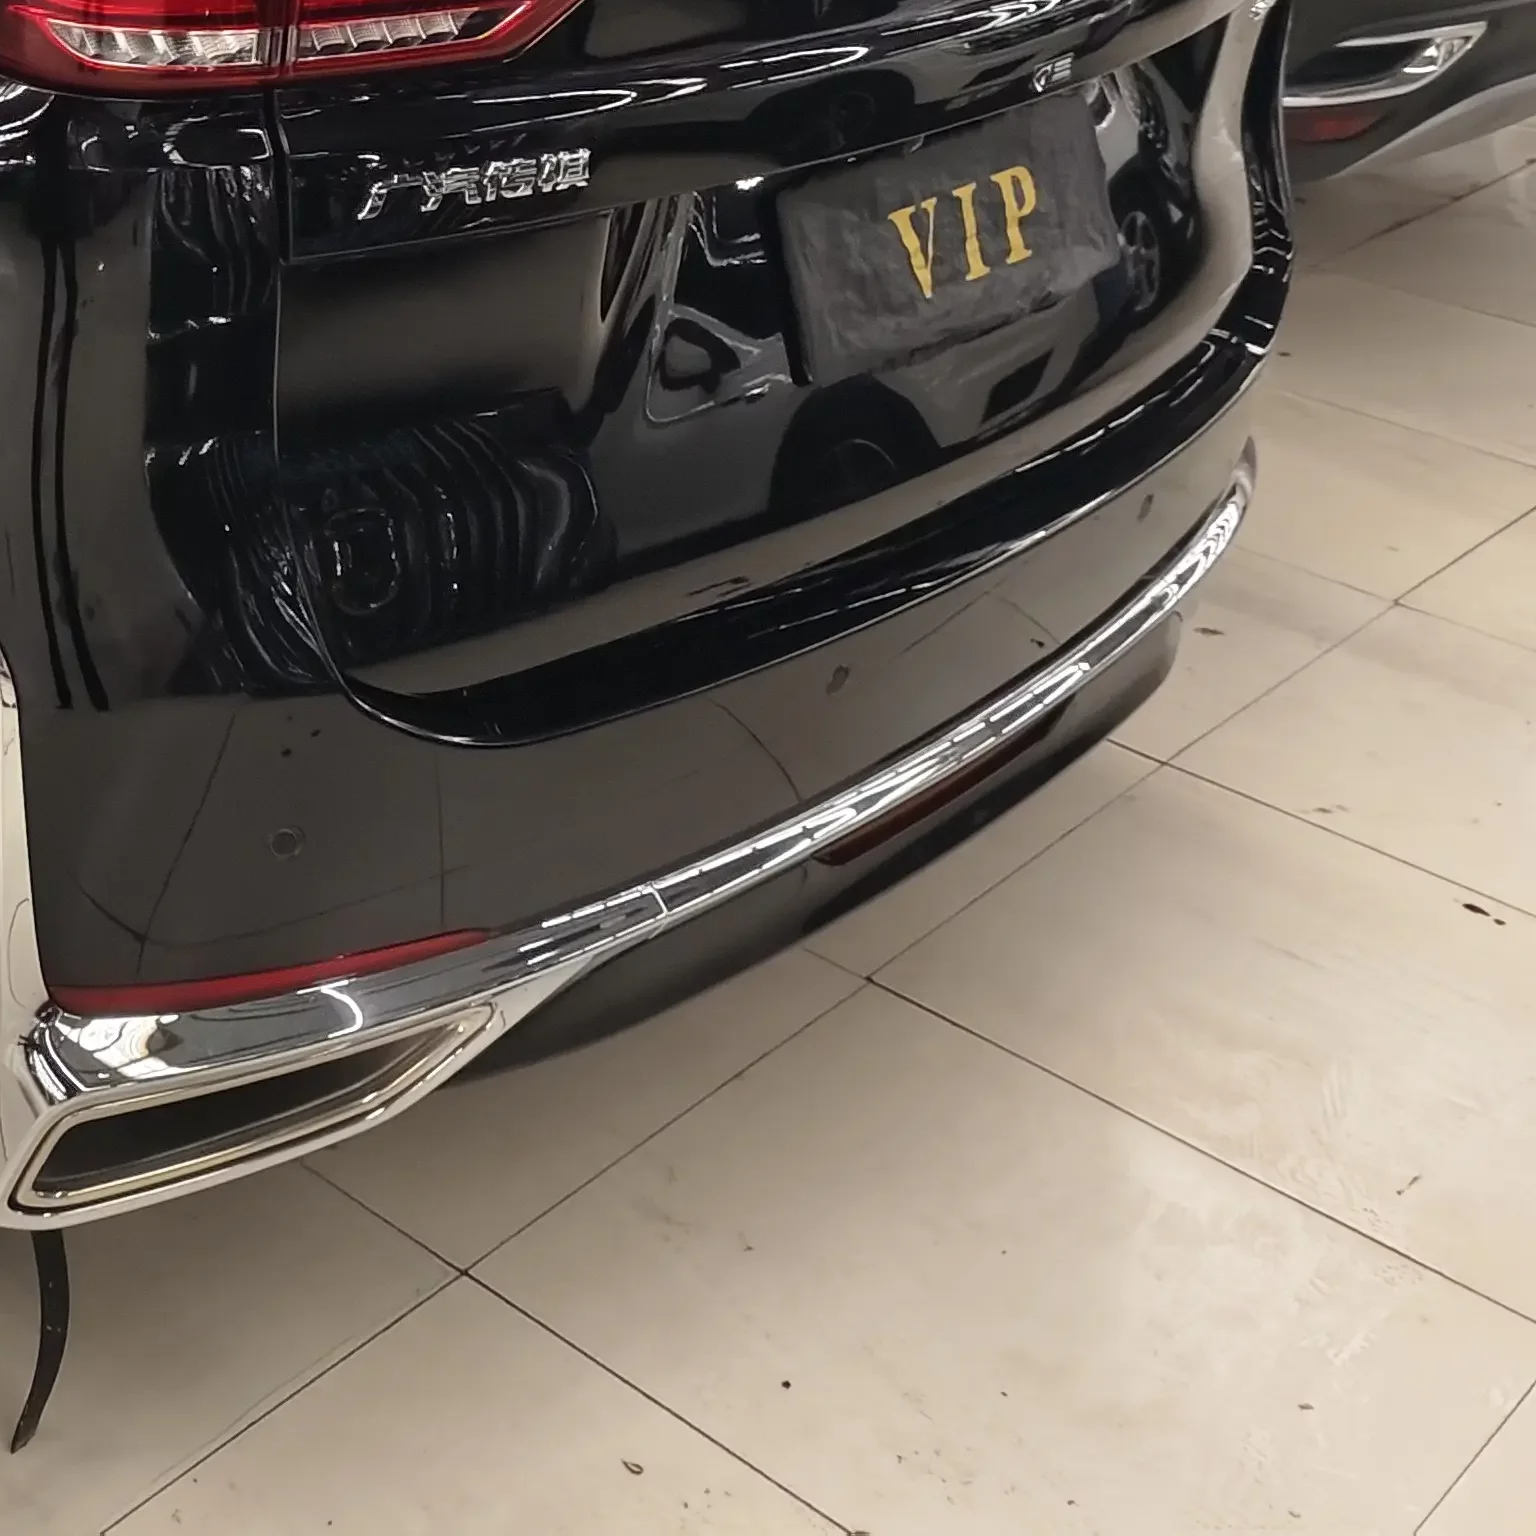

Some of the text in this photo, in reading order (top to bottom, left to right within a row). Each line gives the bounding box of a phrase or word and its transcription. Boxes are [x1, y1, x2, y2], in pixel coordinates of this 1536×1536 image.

[357, 148, 591, 221] 广汽传祺
[888, 166, 1036, 298] VIP
